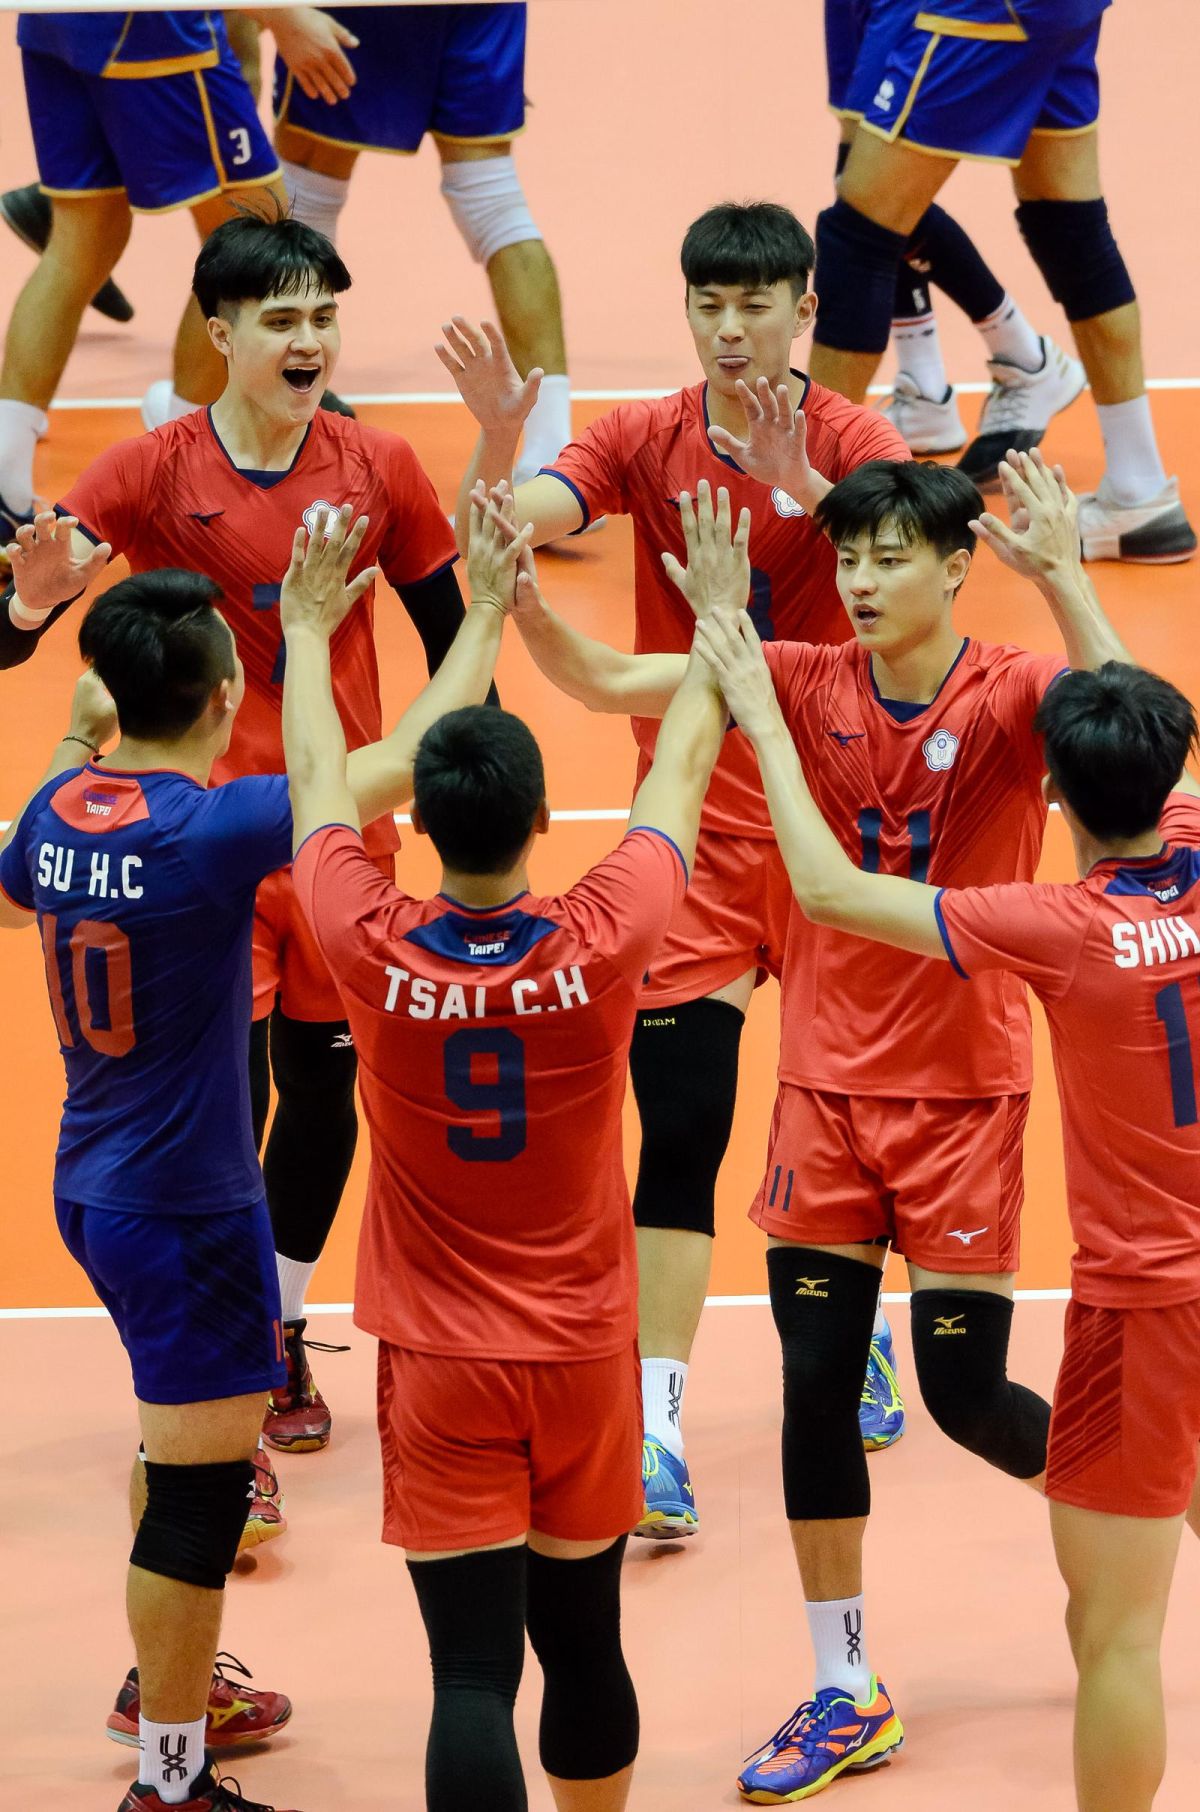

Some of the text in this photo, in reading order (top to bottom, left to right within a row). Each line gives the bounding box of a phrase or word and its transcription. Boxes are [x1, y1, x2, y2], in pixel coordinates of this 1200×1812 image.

[229, 128, 252, 165] 3
[86, 801, 112, 816] TAIPEI
[38, 842, 144, 899] SU H.C
[857, 807, 931, 884] 11
[468, 942, 505, 956] TAIPEI
[1112, 916, 1200, 968] SHIH
[42, 912, 136, 1058] 10
[384, 965, 590, 1020] TSAI C.H
[1155, 982, 1200, 1127] 1
[444, 1027, 526, 1162] 9
[768, 1165, 794, 1212] 11
[272, 1319, 282, 1362] 1
